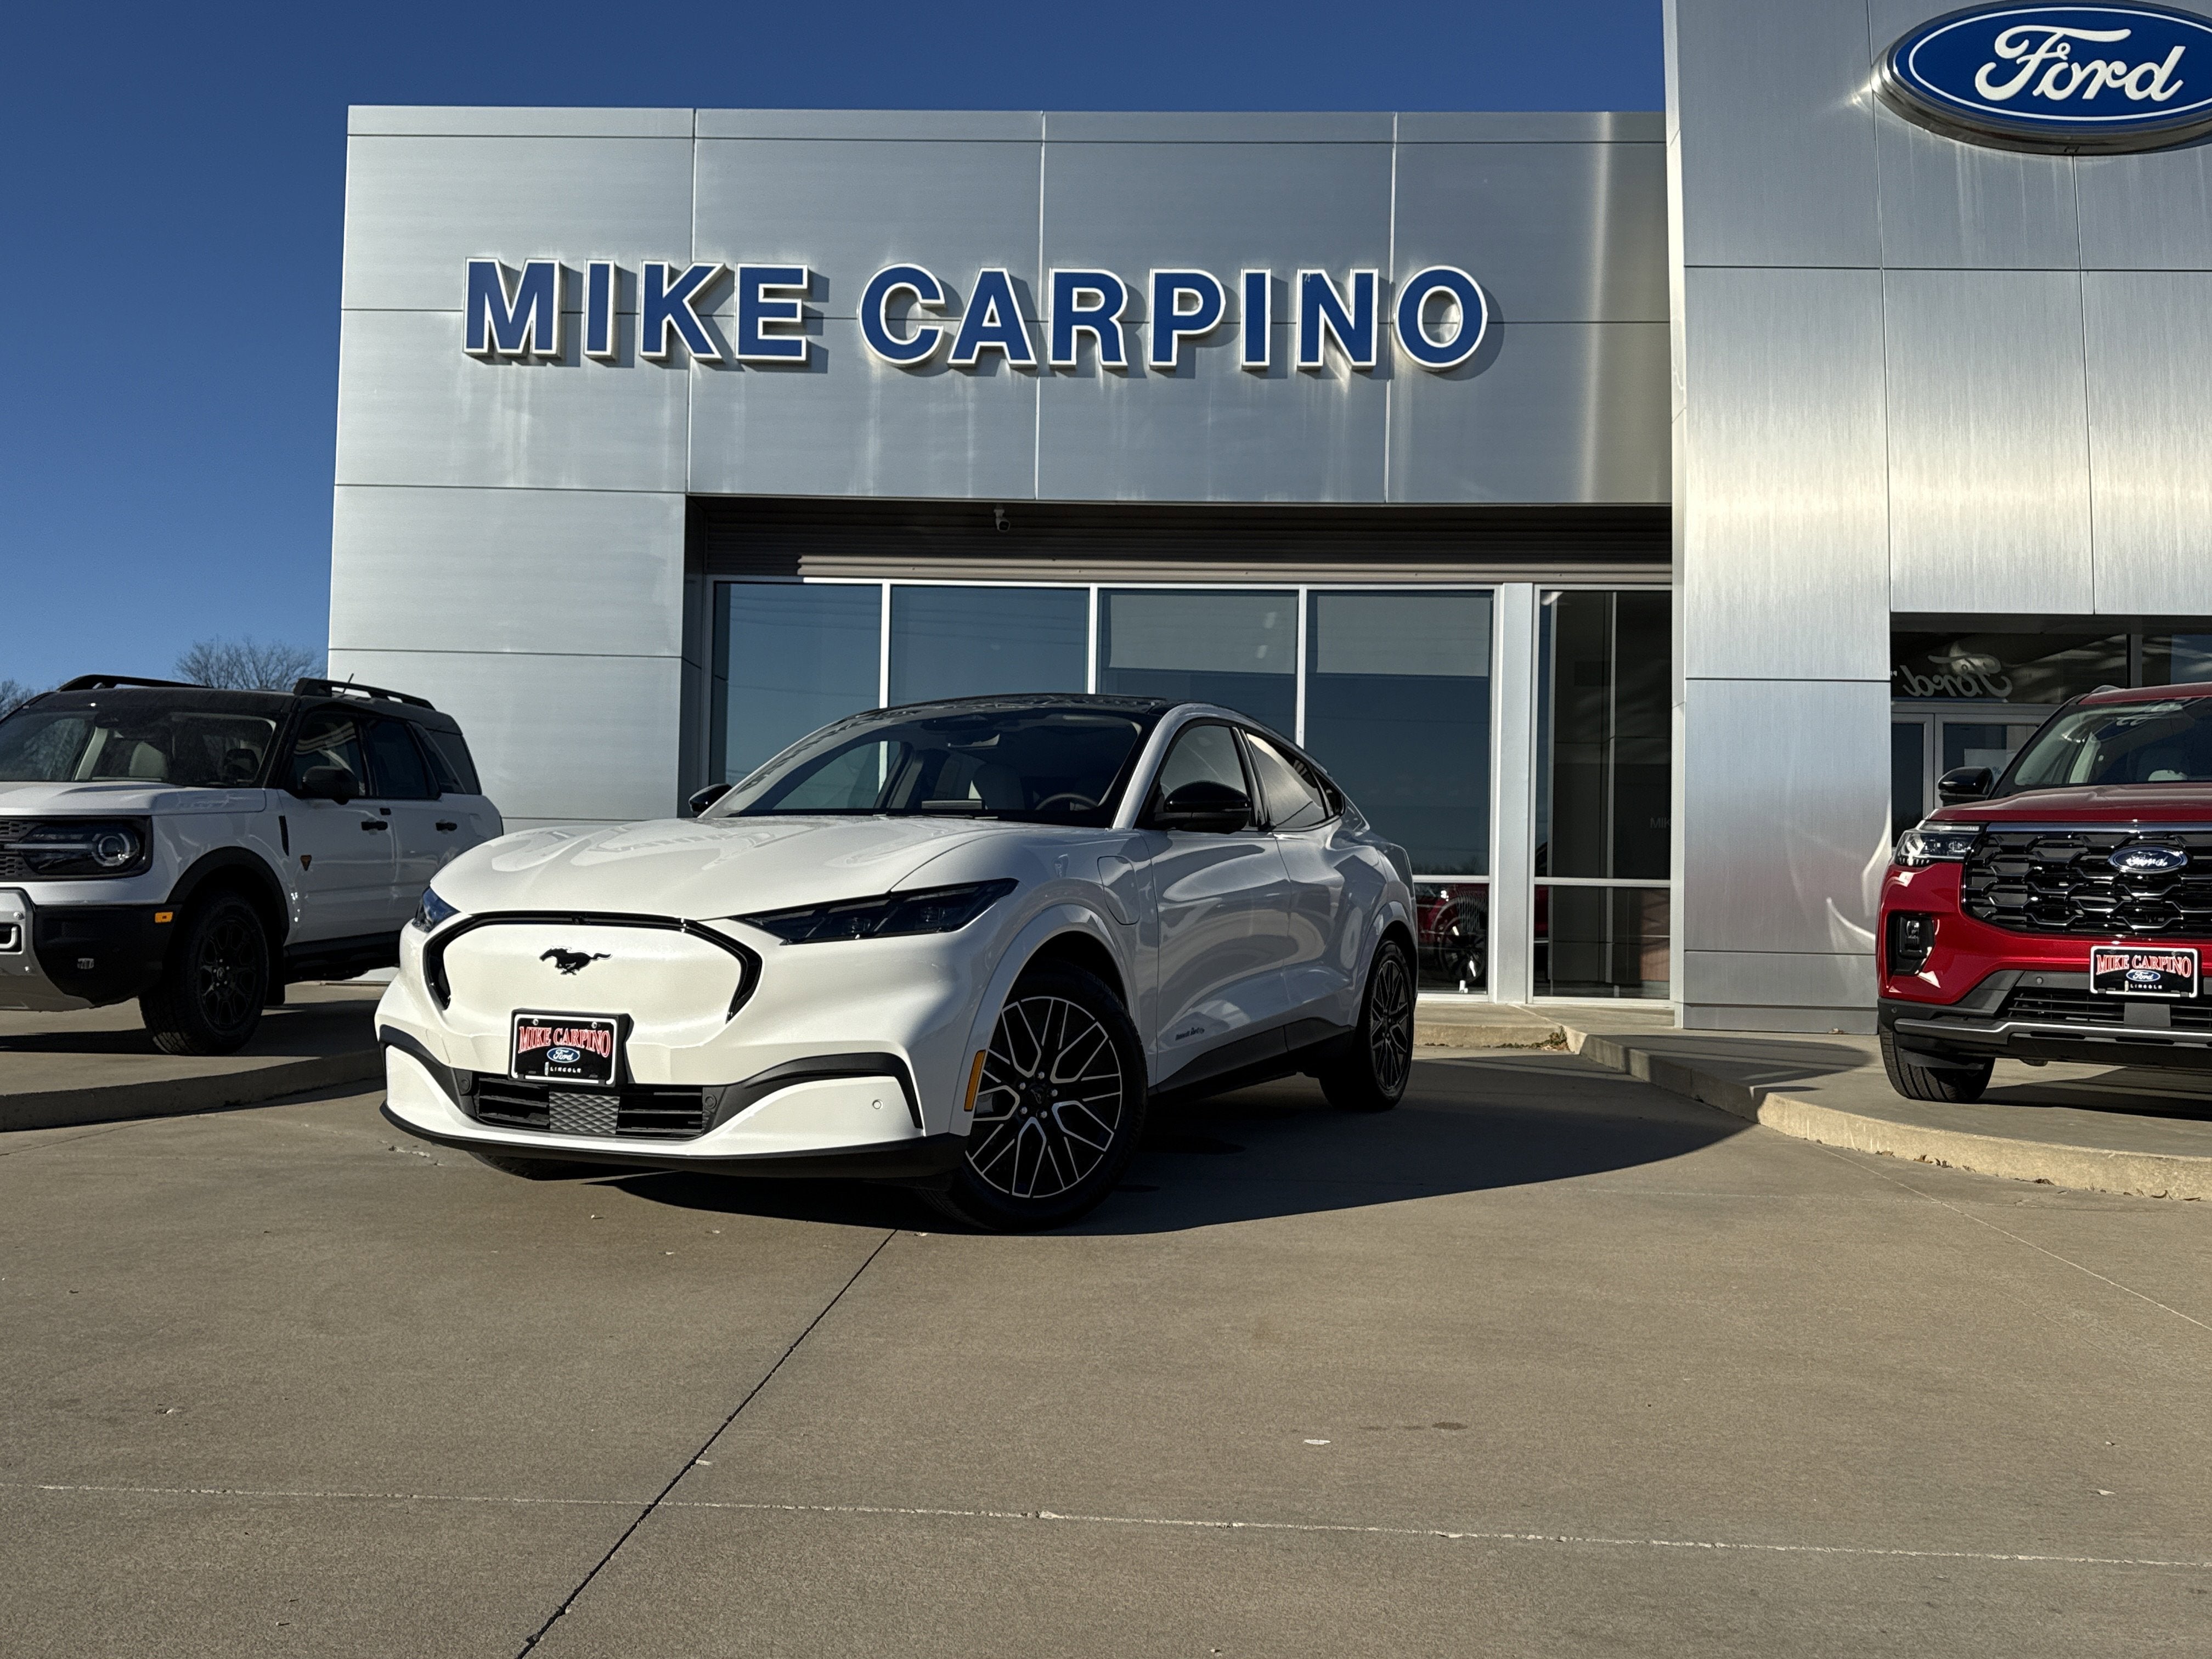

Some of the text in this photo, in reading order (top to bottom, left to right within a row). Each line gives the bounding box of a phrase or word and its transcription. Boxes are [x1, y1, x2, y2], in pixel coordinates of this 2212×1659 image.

[1975, 25, 2186, 101] Ford
[462, 257, 1488, 372] MIKE CARPINO
[2126, 851, 2168, 866] Ford
[2096, 955, 2192, 978] MIKE CARPINO
[518, 1026, 611, 1058] MIKE CARPINO
[552, 1049, 574, 1060] Ford
